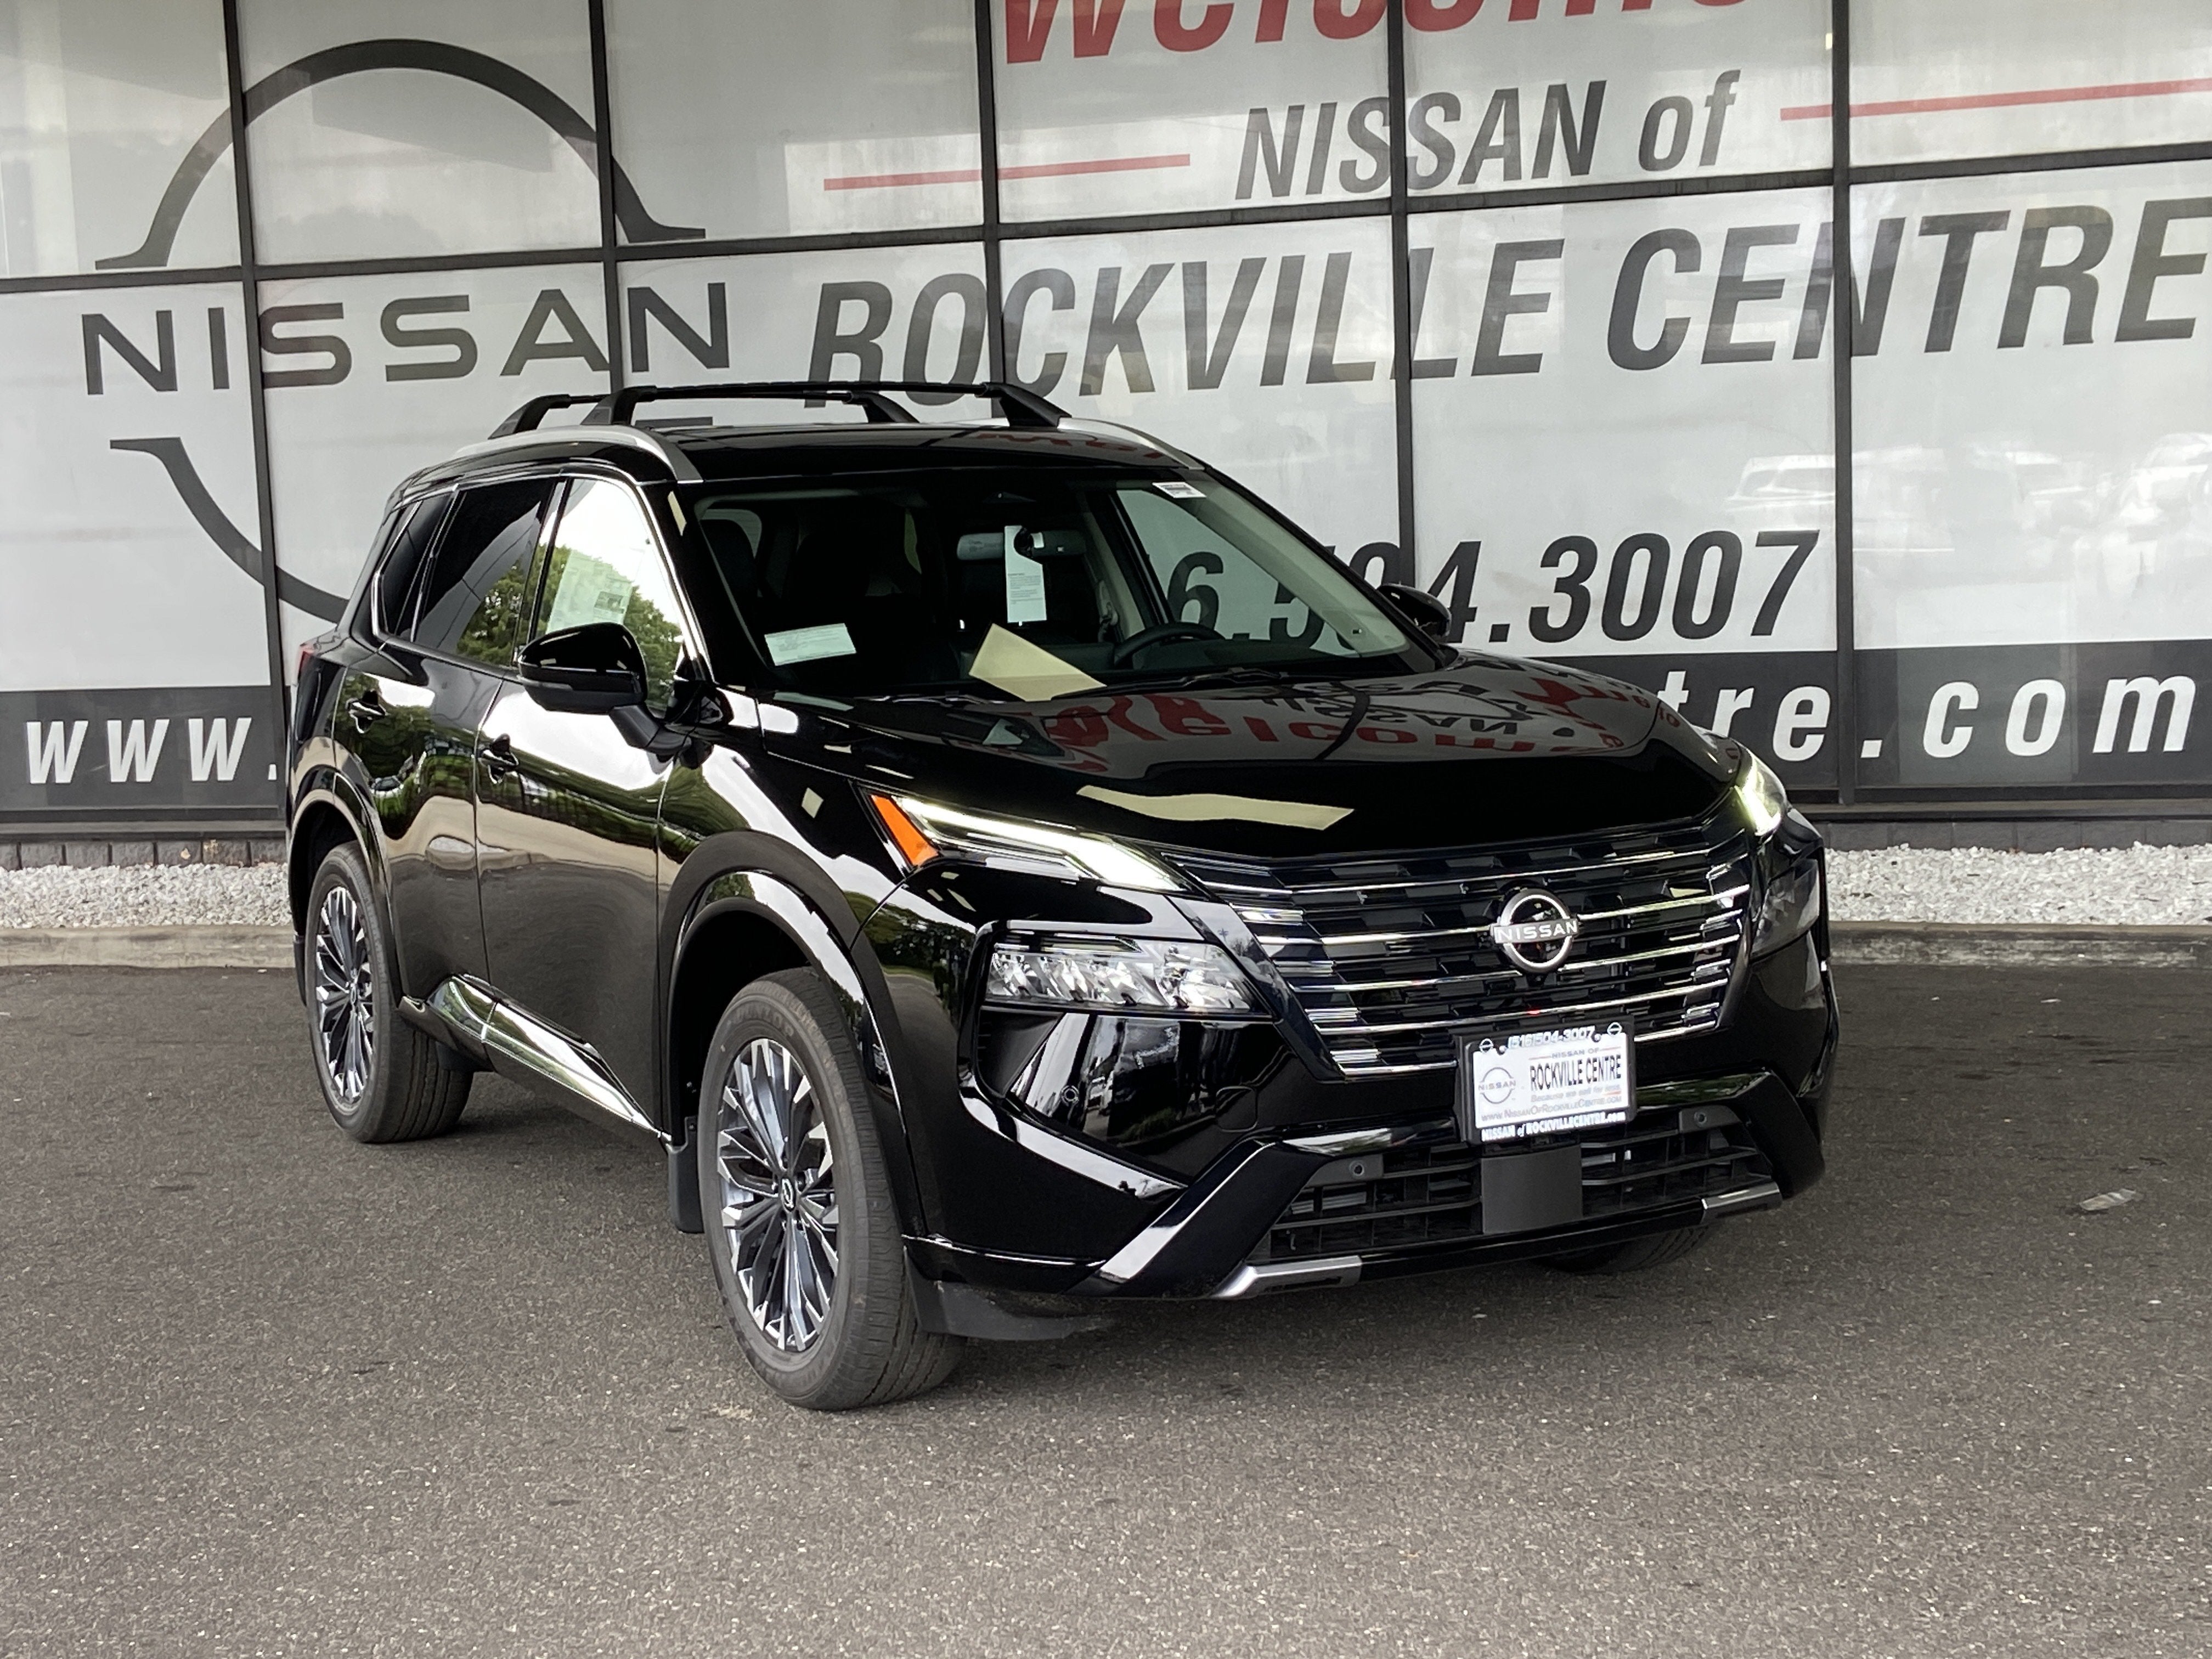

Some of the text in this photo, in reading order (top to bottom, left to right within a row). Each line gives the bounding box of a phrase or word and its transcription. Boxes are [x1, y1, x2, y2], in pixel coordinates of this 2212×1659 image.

[1235, 70, 1740, 200] NISSAN of
[804, 197, 2212, 408] ROCKVILLE CENTRE
[82, 283, 729, 395] NISSAN
[1494, 920, 1578, 942] NISSAN
[1552, 1049, 1584, 1058] NISSAN
[1479, 1080, 1516, 1091] NISSAN
[1530, 1054, 1621, 1091] ROCKVILLE CENTRE
[1482, 1125, 1515, 1142] NISSAN
[1517, 1124, 1526, 1137] of
